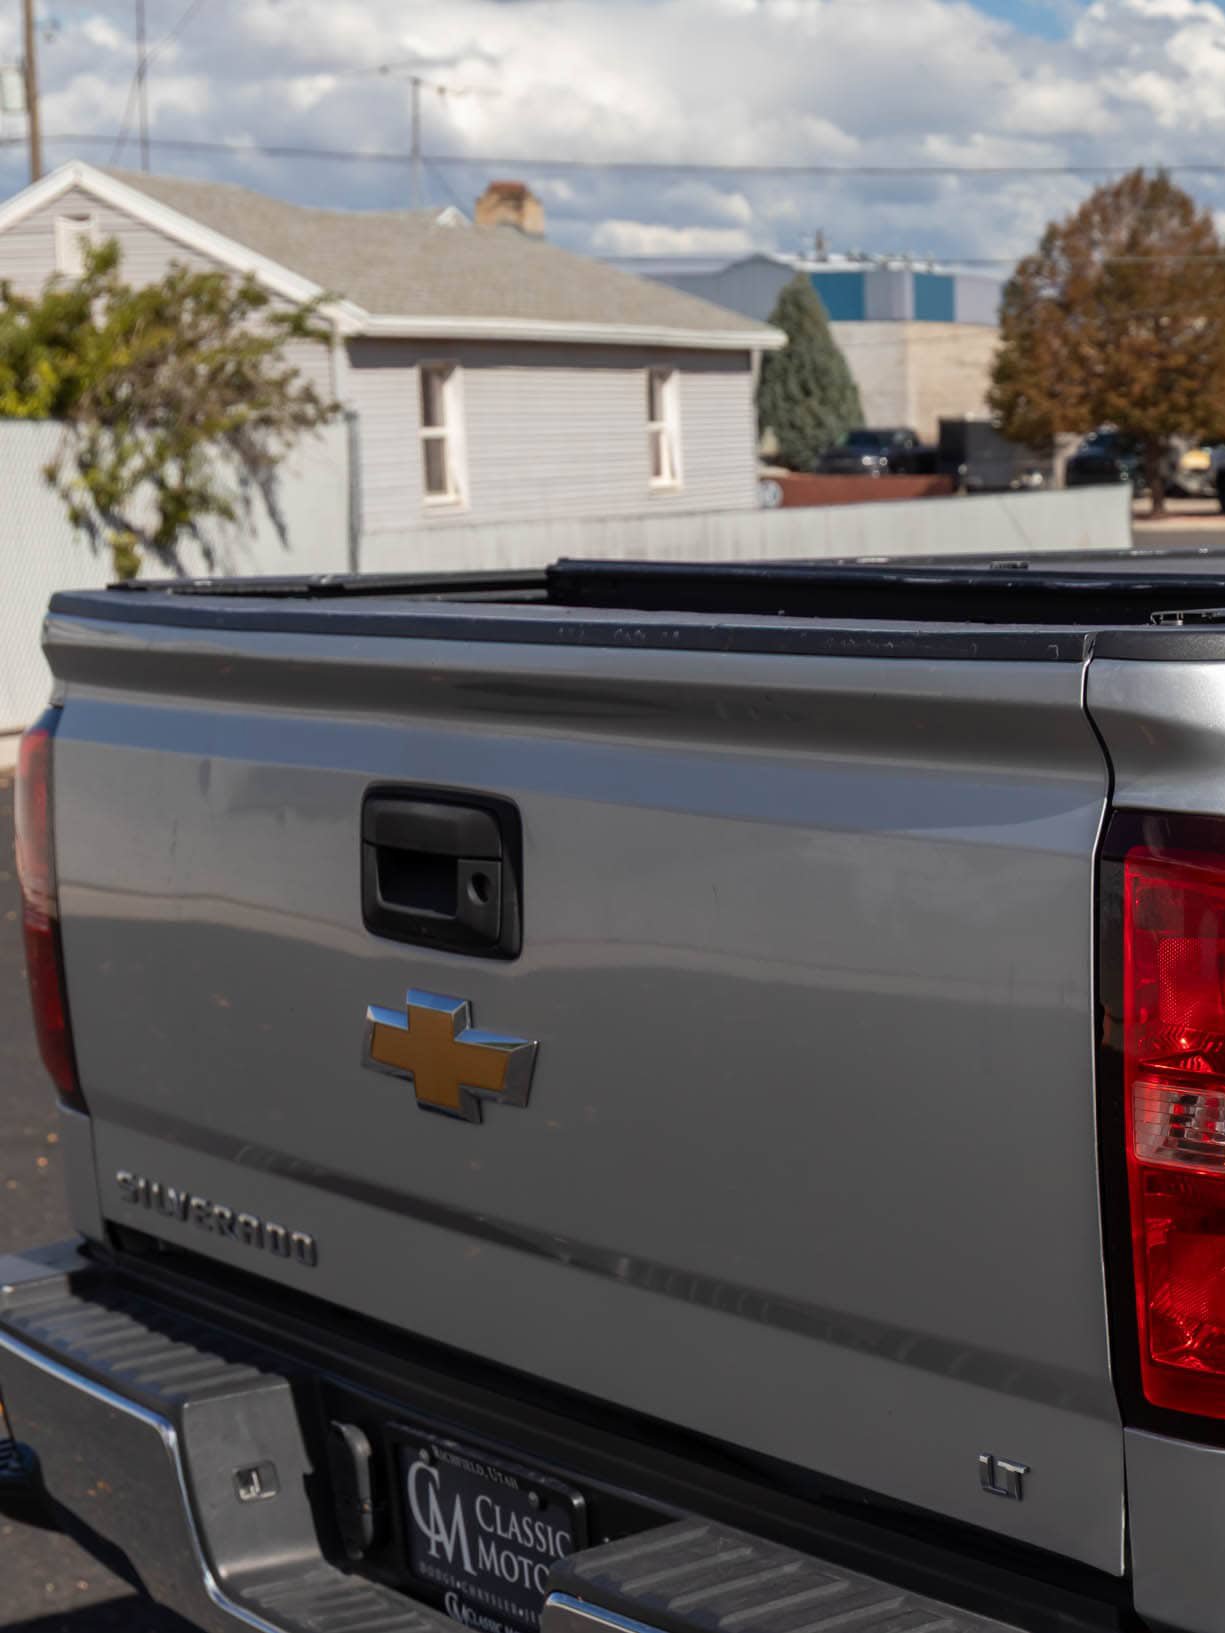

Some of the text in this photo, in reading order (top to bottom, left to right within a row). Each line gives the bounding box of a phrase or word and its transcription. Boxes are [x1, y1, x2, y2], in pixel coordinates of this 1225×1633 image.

[116, 1169, 318, 1267] SILVERADO
[977, 1452, 1030, 1502] LT
[475, 1494, 571, 1559] CLASSIC
[477, 1537, 550, 1595] MOTO
